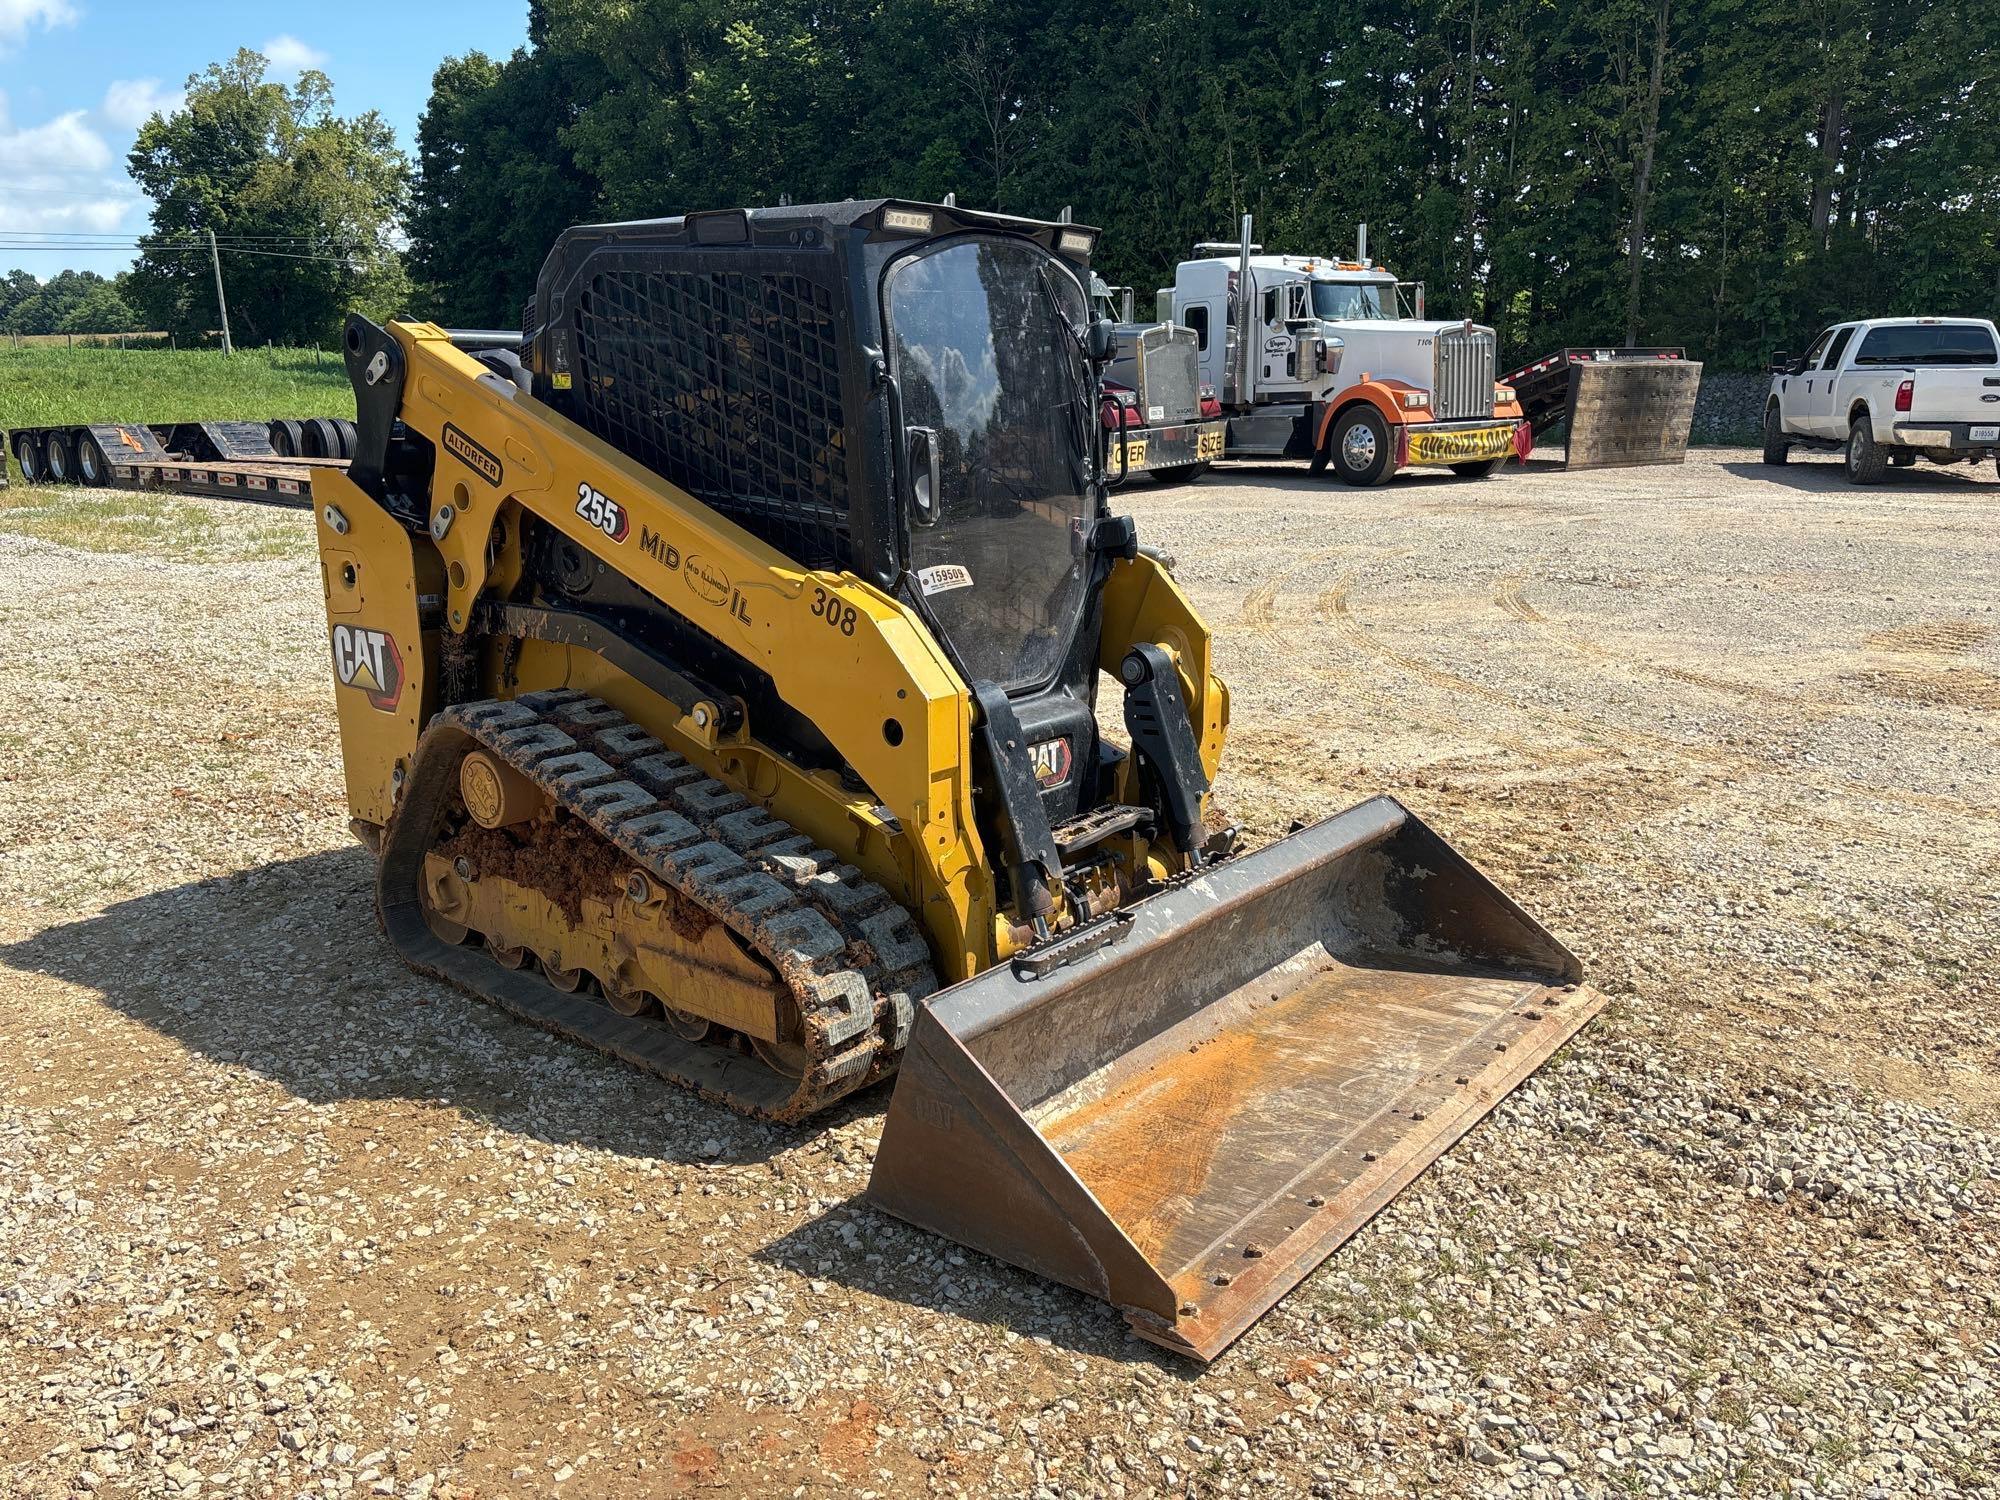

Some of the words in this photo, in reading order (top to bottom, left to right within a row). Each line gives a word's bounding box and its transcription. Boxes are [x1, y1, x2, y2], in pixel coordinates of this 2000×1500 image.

[448, 433, 497, 477] ALTORFER
[1115, 445, 1145, 464] OER
[1201, 435, 1222, 454] SIZE
[1420, 432, 1478, 459] OVERSIZE
[1481, 429, 1509, 455] LOAD
[576, 482, 619, 536] 255
[929, 568, 965, 584] 159509
[730, 587, 752, 627] IL
[810, 587, 857, 637] 308
[333, 625, 386, 692] CAT
